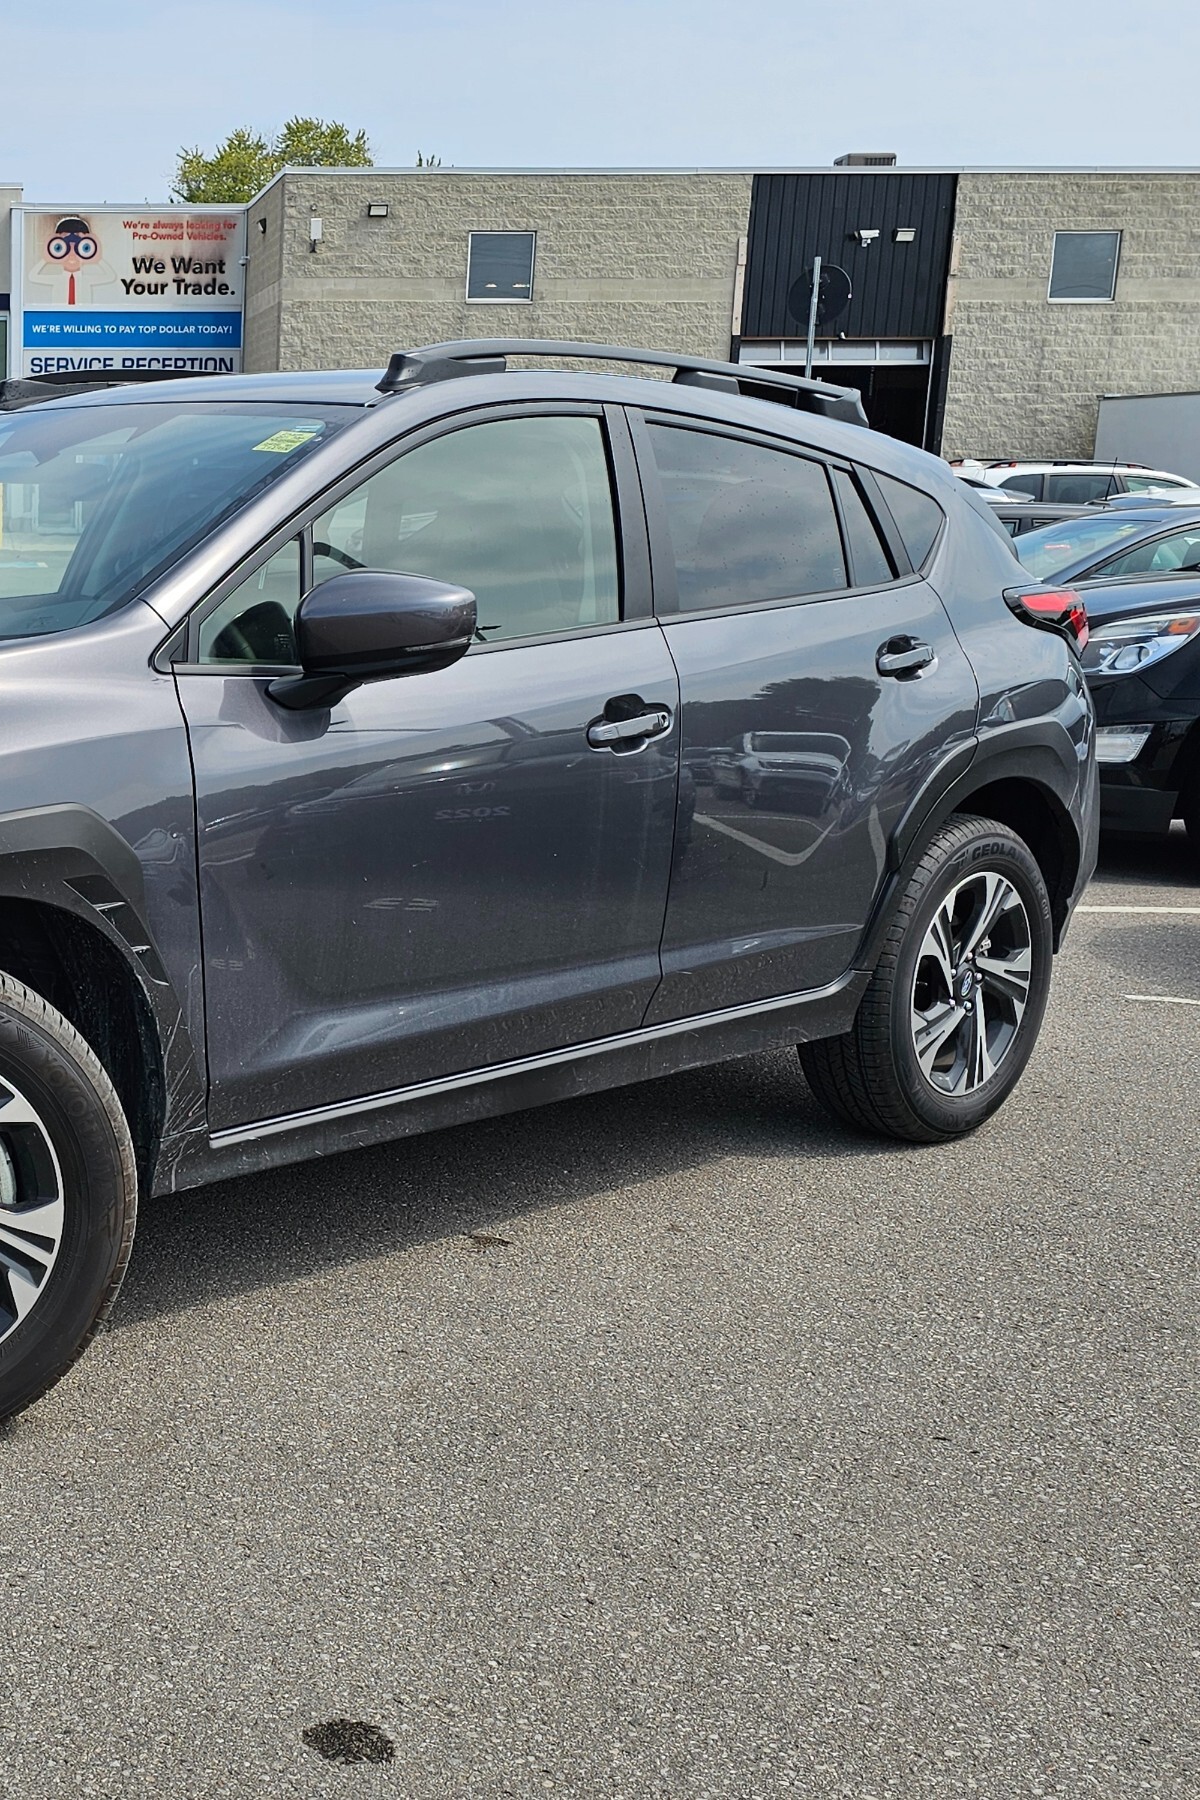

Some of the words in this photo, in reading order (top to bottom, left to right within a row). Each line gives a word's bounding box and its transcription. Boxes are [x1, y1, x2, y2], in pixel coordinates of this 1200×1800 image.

[122, 221, 149, 230] We're
[152, 221, 184, 232] always
[186, 221, 220, 232] looking
[223, 221, 237, 230] for
[133, 232, 183, 240] Pre-Owned
[187, 232, 226, 240] Vehicles.
[132, 257, 165, 274] We
[171, 257, 225, 274] Want
[121, 279, 168, 295] Your
[173, 279, 236, 295] Trade.
[32, 325, 60, 334] WE'RE
[63, 325, 101, 334] WILLING
[104, 325, 116, 334] TO
[119, 325, 135, 334] PAY
[138, 325, 157, 334] TOP
[160, 325, 195, 334] DOLLAR
[198, 325, 232, 334] TODAY!
[31, 357, 113, 373] SERVICE
[122, 357, 233, 373] RECEPTION
